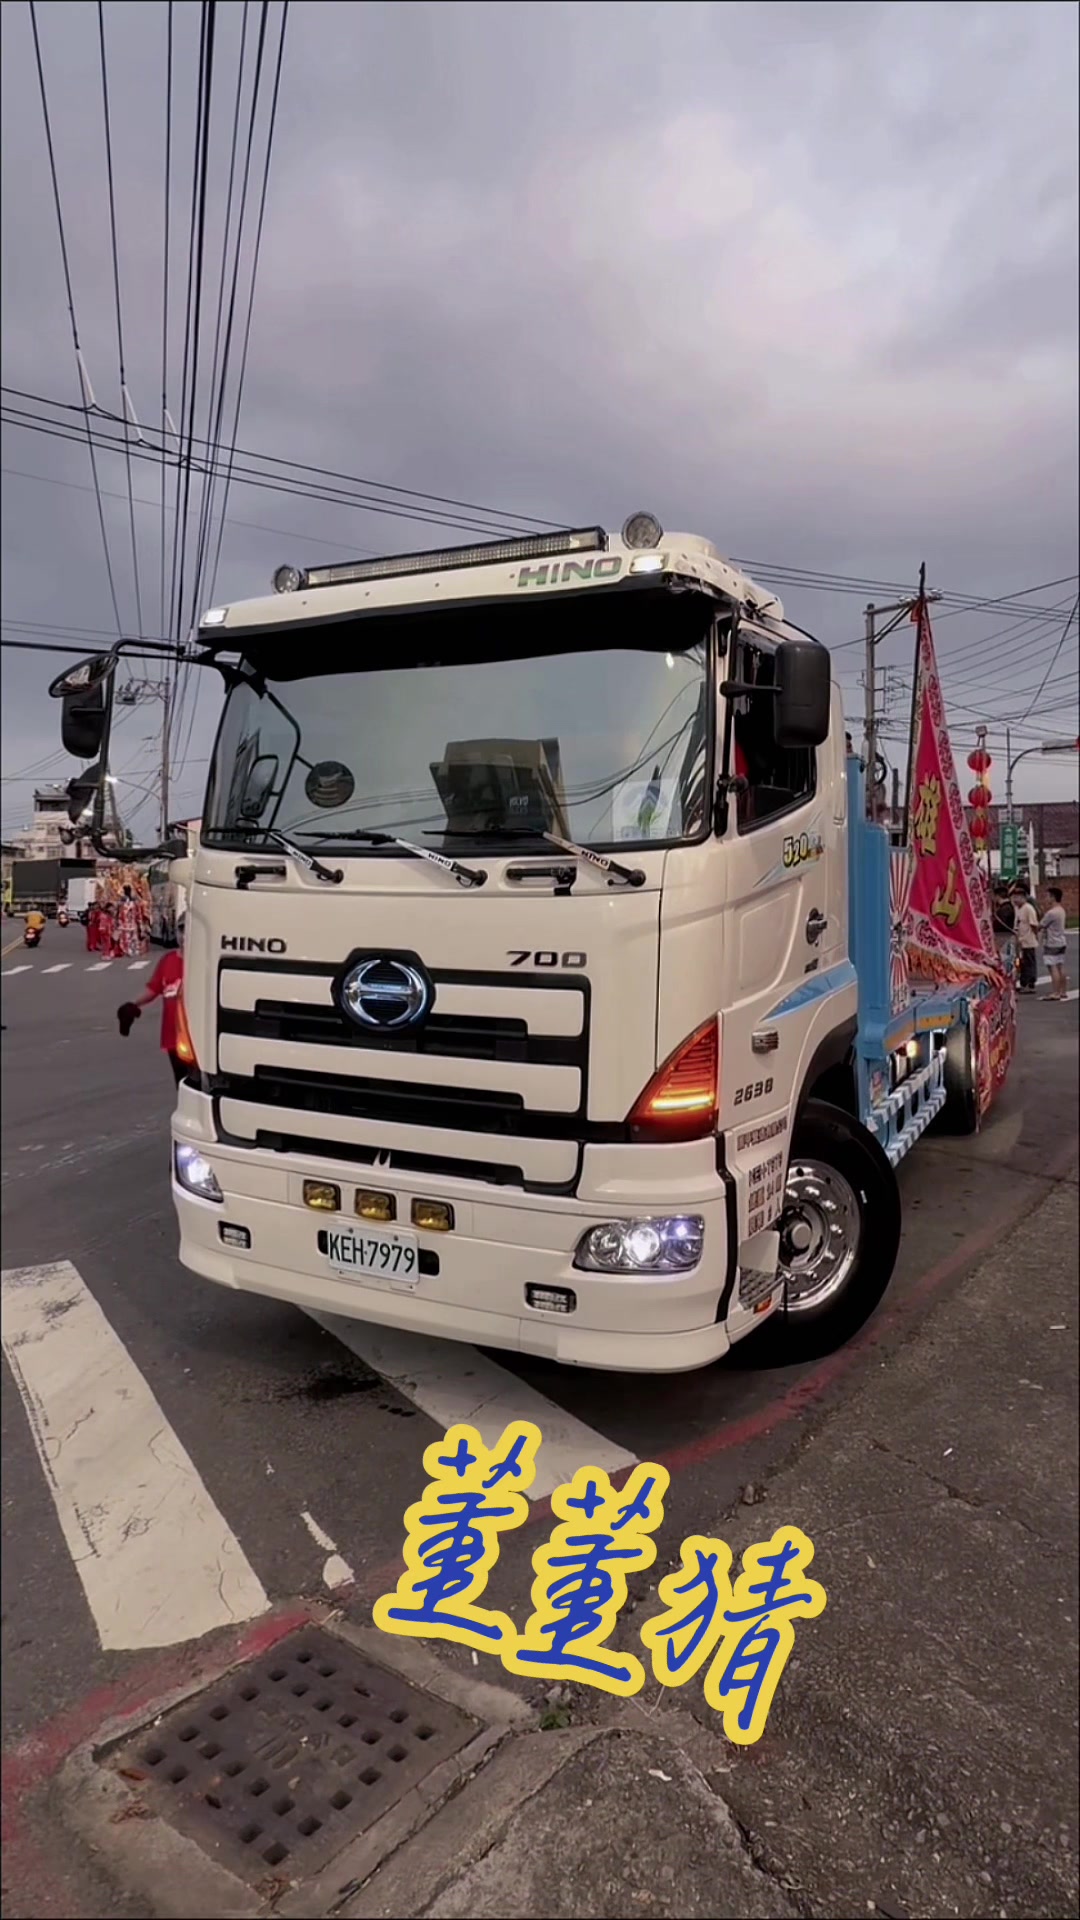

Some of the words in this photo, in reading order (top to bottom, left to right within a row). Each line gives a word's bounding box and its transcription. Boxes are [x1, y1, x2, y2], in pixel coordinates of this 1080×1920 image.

[517, 556, 622, 588] HINO
[221, 934, 288, 954] HINO
[506, 950, 588, 969] 700
[733, 1077, 774, 1106] 2638
